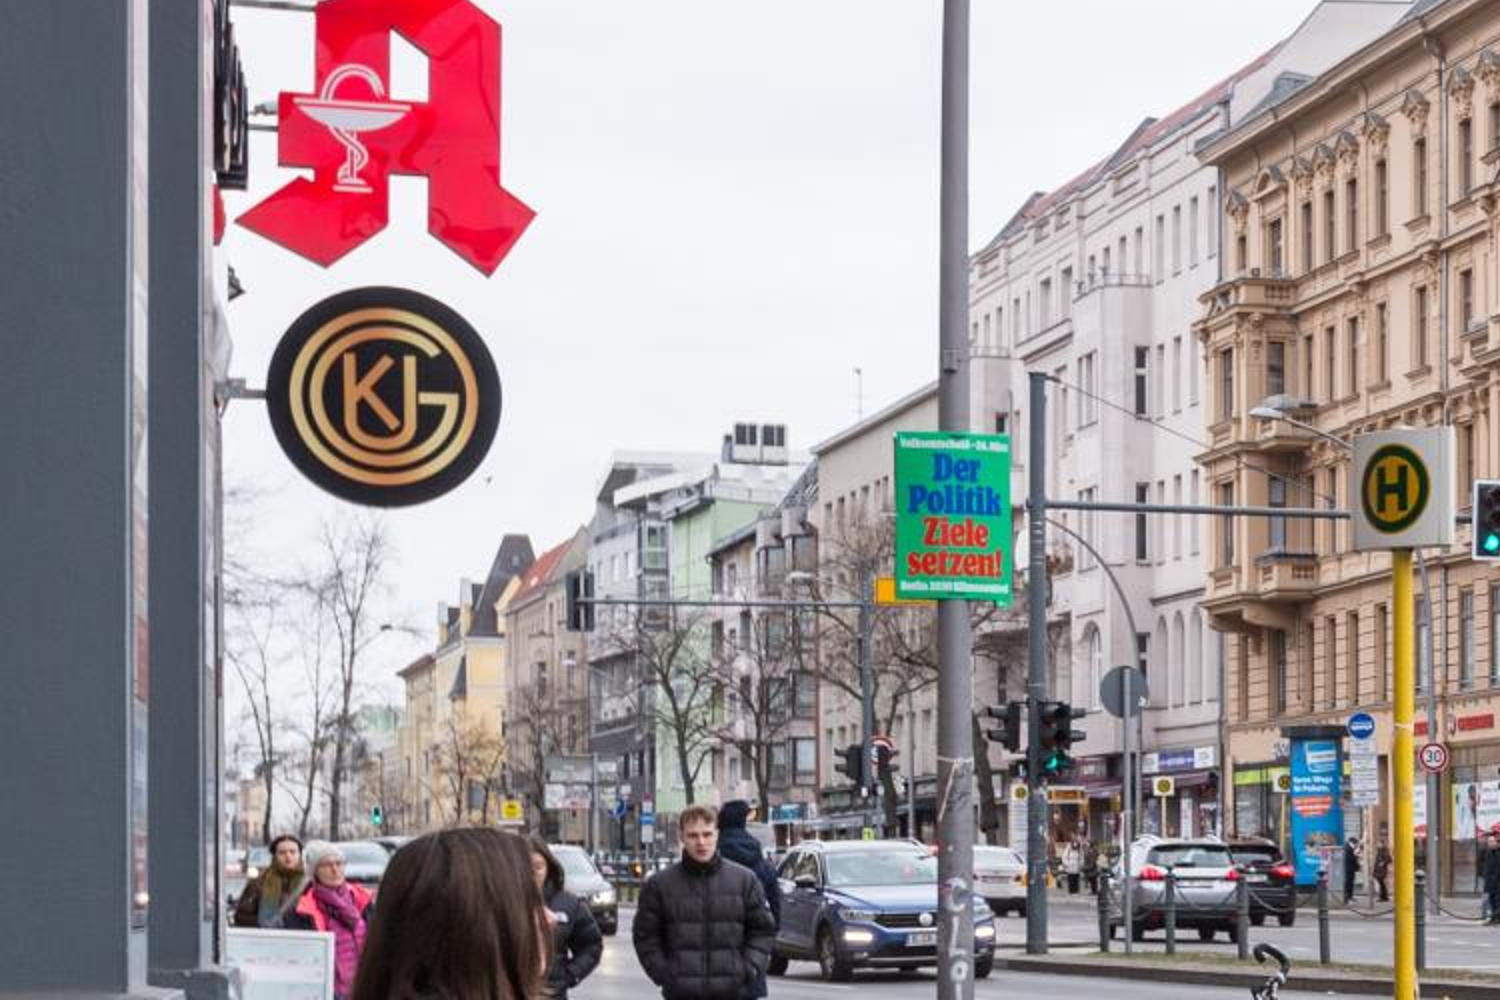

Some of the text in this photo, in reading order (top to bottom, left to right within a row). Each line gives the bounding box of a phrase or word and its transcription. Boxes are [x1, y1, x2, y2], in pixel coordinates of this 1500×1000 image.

[932, 452, 981, 483] Der
[908, 484, 1001, 516] Politik
[1376, 465, 1408, 512] H
[923, 517, 989, 547] Ziele
[907, 550, 1002, 577] setzen!
[1426, 750, 1441, 763] 30
